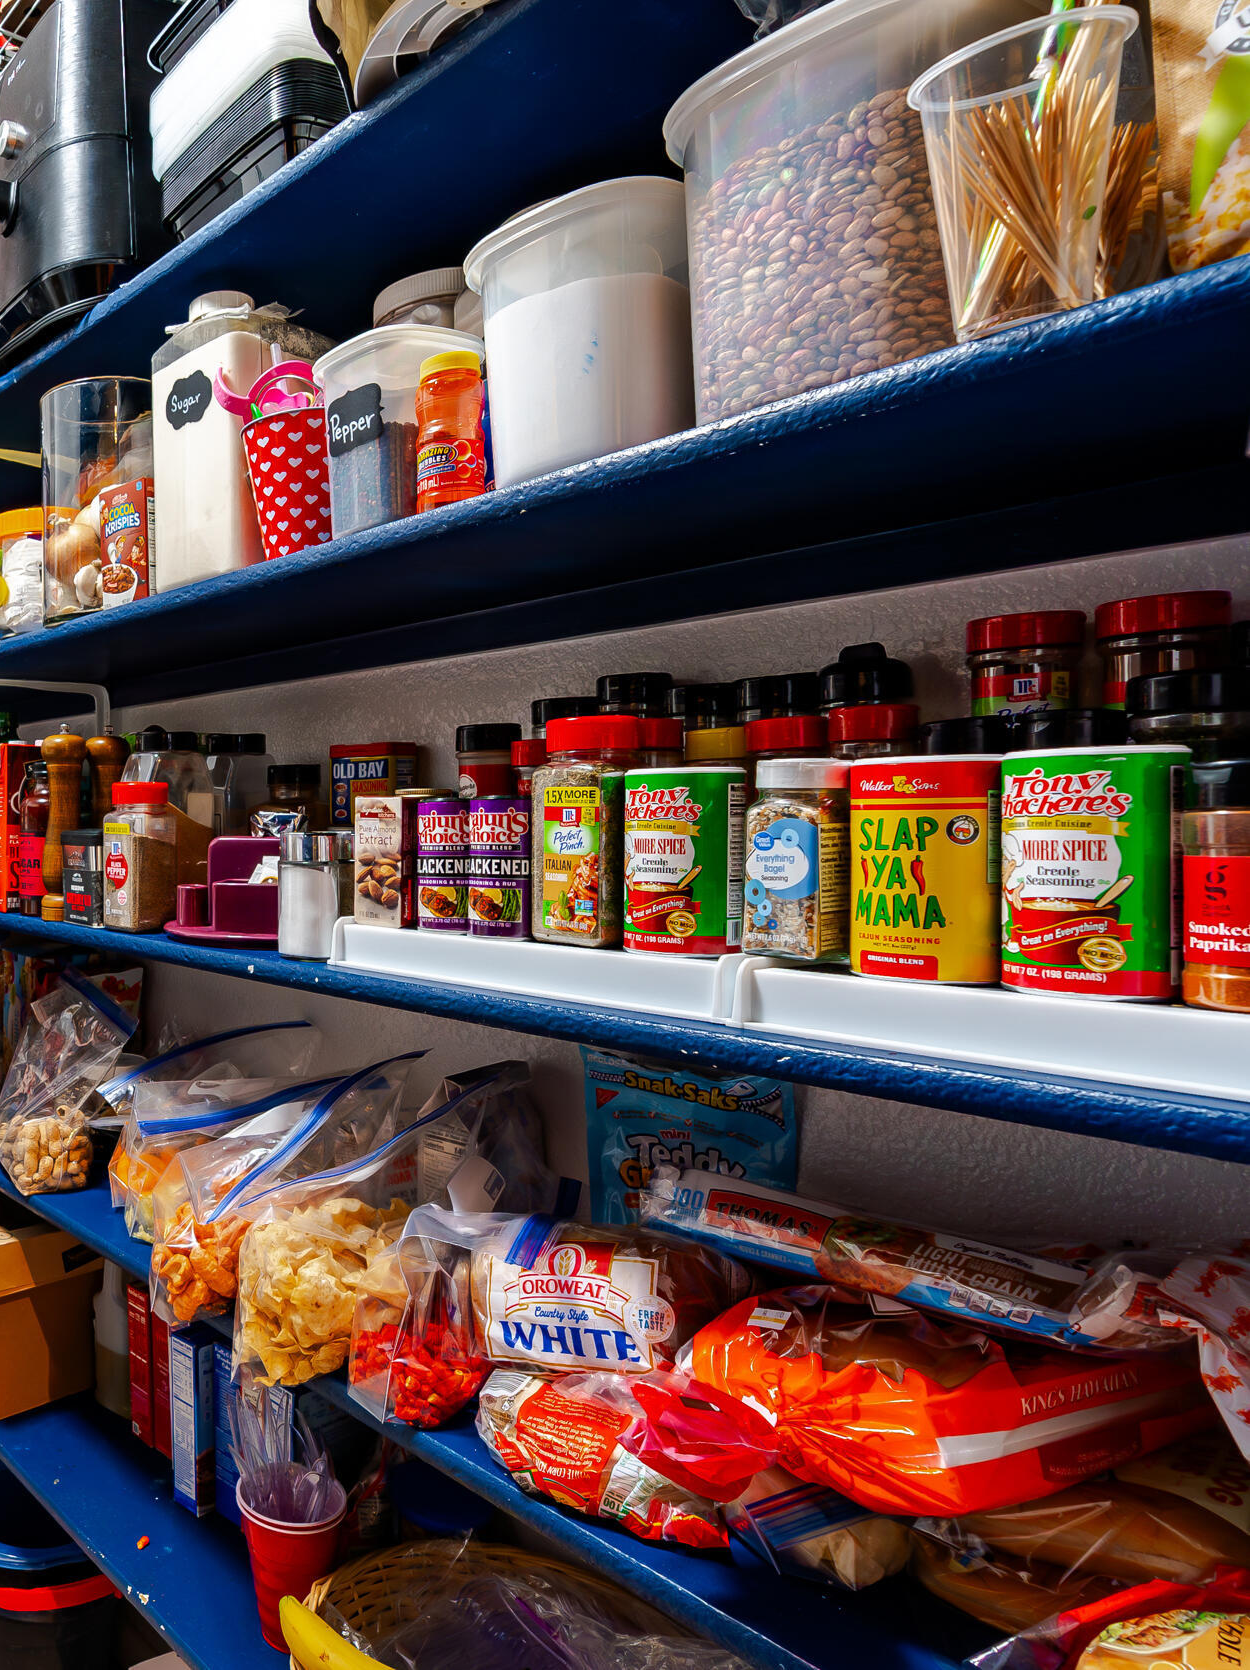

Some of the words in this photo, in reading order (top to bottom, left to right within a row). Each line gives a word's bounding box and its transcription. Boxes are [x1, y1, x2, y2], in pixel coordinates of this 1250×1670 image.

[171, 391, 201, 415] Sugar
[330, 412, 375, 446] Pepper
[109, 502, 135, 522] COCOA
[105, 512, 140, 539] KRISPIES
[333, 764, 356, 780] OLD
[358, 761, 385, 778] BAY
[352, 780, 388, 793] SEASONING
[860, 780, 894, 792] Walker
[911, 779, 940, 791] Sons
[1013, 768, 1110, 797] Tony
[546, 790, 563, 804] 1.5X
[564, 789, 596, 799] MORE
[629, 784, 689, 807] Tony
[1003, 786, 1132, 816] hachere's
[625, 799, 701, 821] hachere's
[470, 807, 528, 834] ajun's
[1056, 820, 1092, 829] Cuisine
[359, 825, 372, 833] Pure
[373, 825, 396, 833] Almond
[553, 829, 582, 845] Perfect
[859, 816, 939, 851] SLAP
[359, 833, 393, 846] Extract
[559, 840, 584, 855] Pinch
[634, 839, 656, 854] MORE
[658, 838, 686, 855] SPICE
[1022, 840, 1060, 861] MORE
[1063, 840, 1107, 861] SPICE
[469, 859, 529, 875] ACKENED
[545, 859, 572, 871] ITALIAN
[642, 857, 668, 866] Creole
[756, 853, 795, 866] Everything
[107, 867, 126, 876] PEPPER
[635, 865, 678, 875] Seasoning
[763, 864, 785, 874] Bagel
[871, 854, 907, 890] YA
[1037, 866, 1080, 877] Creole
[760, 874, 788, 882] Seasoning
[1026, 875, 1095, 888] Seasoning
[652, 898, 686, 913] Everything!
[855, 889, 946, 930] MAMA
[679, 921, 694, 929] MSG
[658, 936, 684, 945] GRAMS)
[859, 932, 880, 941] CAJUN
[883, 936, 940, 945] SEASONING
[1021, 933, 1042, 946] Great
[1043, 932, 1054, 942] on
[1055, 921, 1108, 938] Everything!
[1189, 936, 1250, 953] Paprika
[868, 955, 897, 963] ORIGINAL
[1083, 947, 1098, 957] NO
[1099, 950, 1122, 962] MSG
[1026, 967, 1040, 978] OZ.
[1041, 967, 1062, 980] (198
[1063, 970, 1107, 983] GRAMS)
[624, 1071, 740, 1112] Snak-Saks
[660, 1128, 690, 1141] mini
[626, 1134, 746, 1178] Teddy
[674, 1187, 704, 1210] 100
[914, 1243, 971, 1267] LIGHT
[522, 1279, 606, 1299] OROWEAT
[534, 1306, 566, 1322] Country
[567, 1308, 589, 1324] Style
[638, 1309, 665, 1322] FRESH
[638, 1319, 664, 1332] TASTE
[499, 1320, 641, 1363] WHITE
[1020, 1385, 1065, 1417] KING'S
[1070, 1368, 1141, 1403] HAWAIIAN
[547, 1466, 566, 1478] CORN
